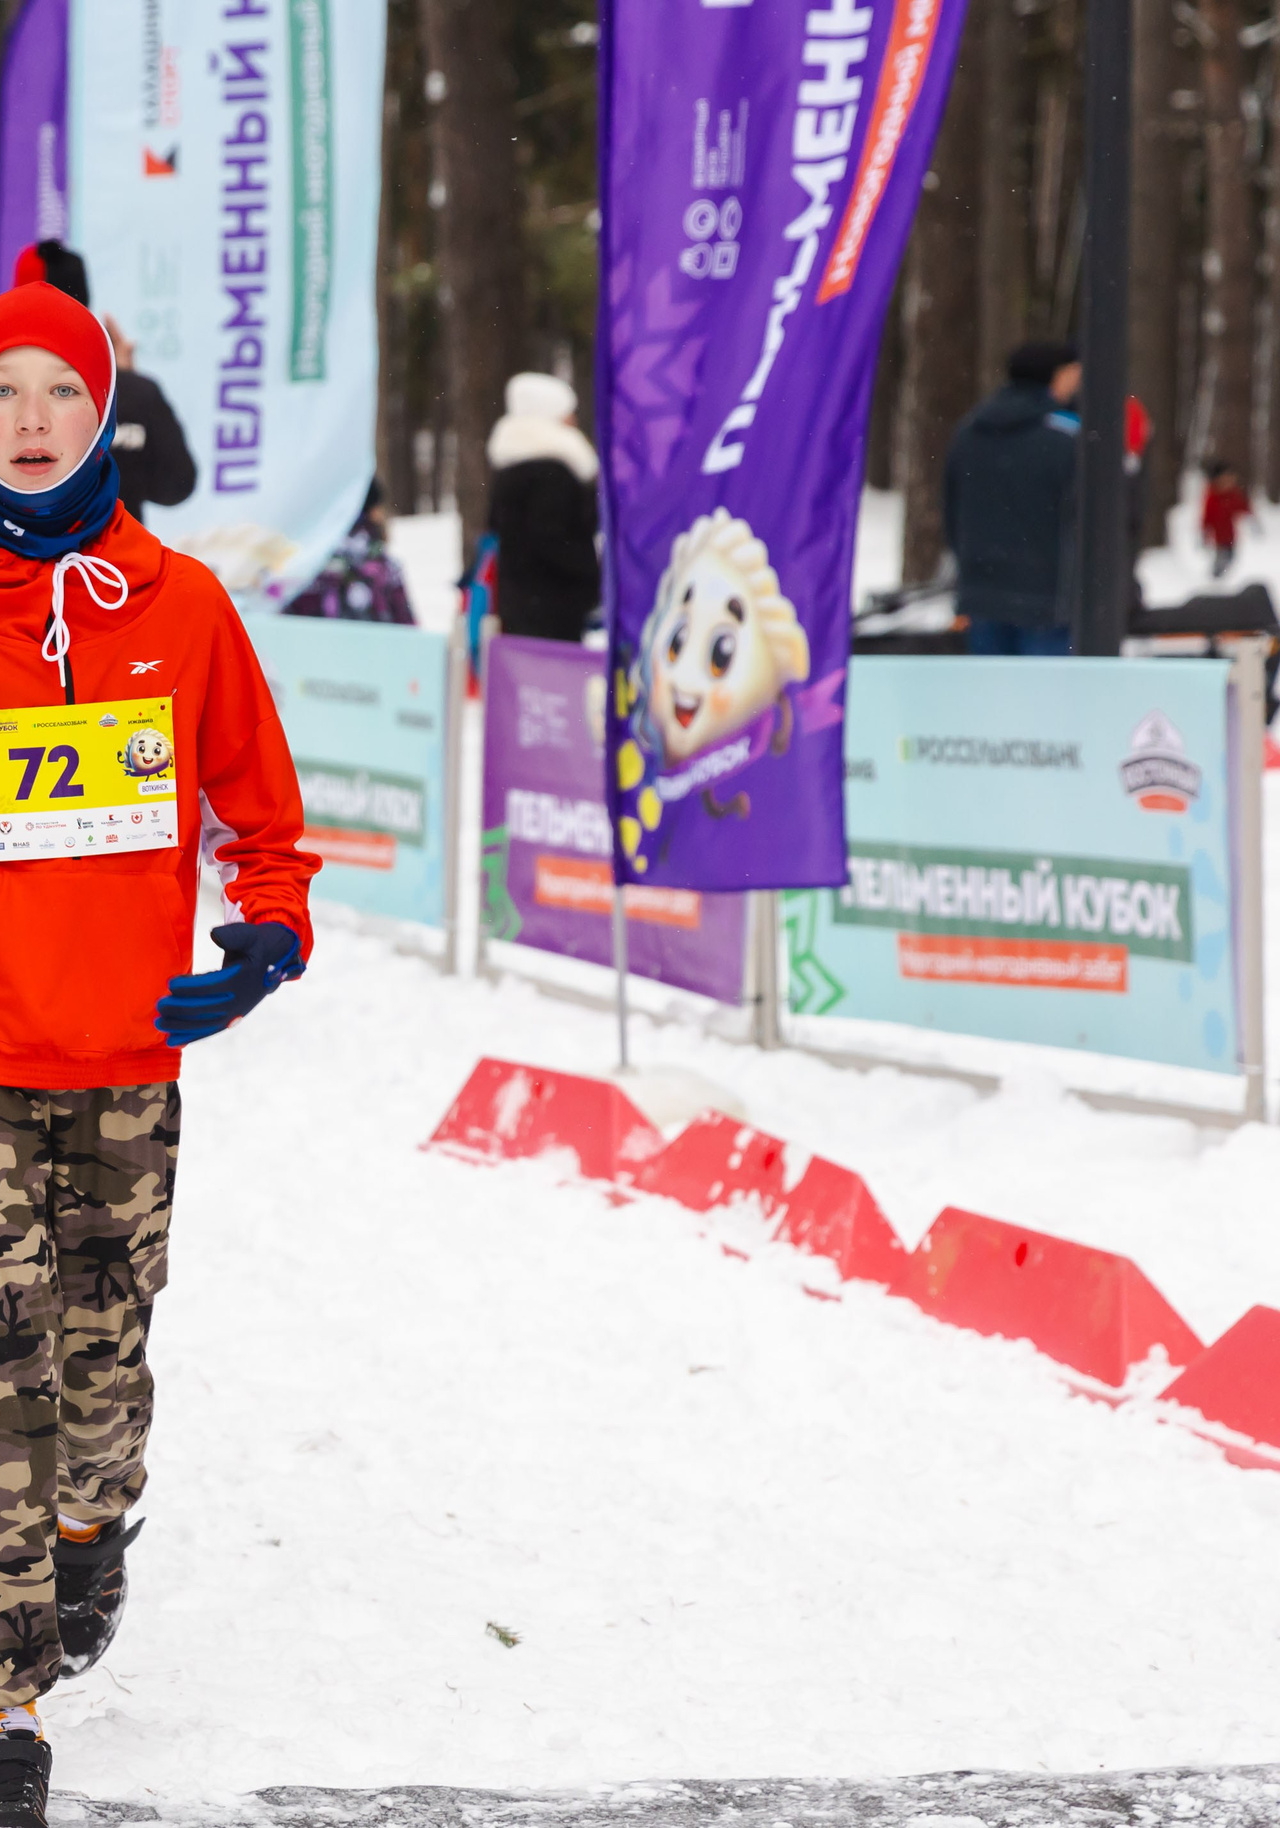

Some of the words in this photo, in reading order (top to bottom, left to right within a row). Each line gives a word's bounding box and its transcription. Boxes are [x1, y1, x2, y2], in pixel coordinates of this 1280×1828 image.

[208, 38, 270, 493] ПЕЛЬМЕННЫЙ
[36, 720, 88, 728] РОССЕЛЬХОЗБАНК
[8, 744, 85, 801] 72
[141, 783, 169, 793] ВОТКИНСК
[841, 856, 1062, 928] ПЕЛЬМЕННЫЙ
[1062, 873, 1183, 941] КУБОК
